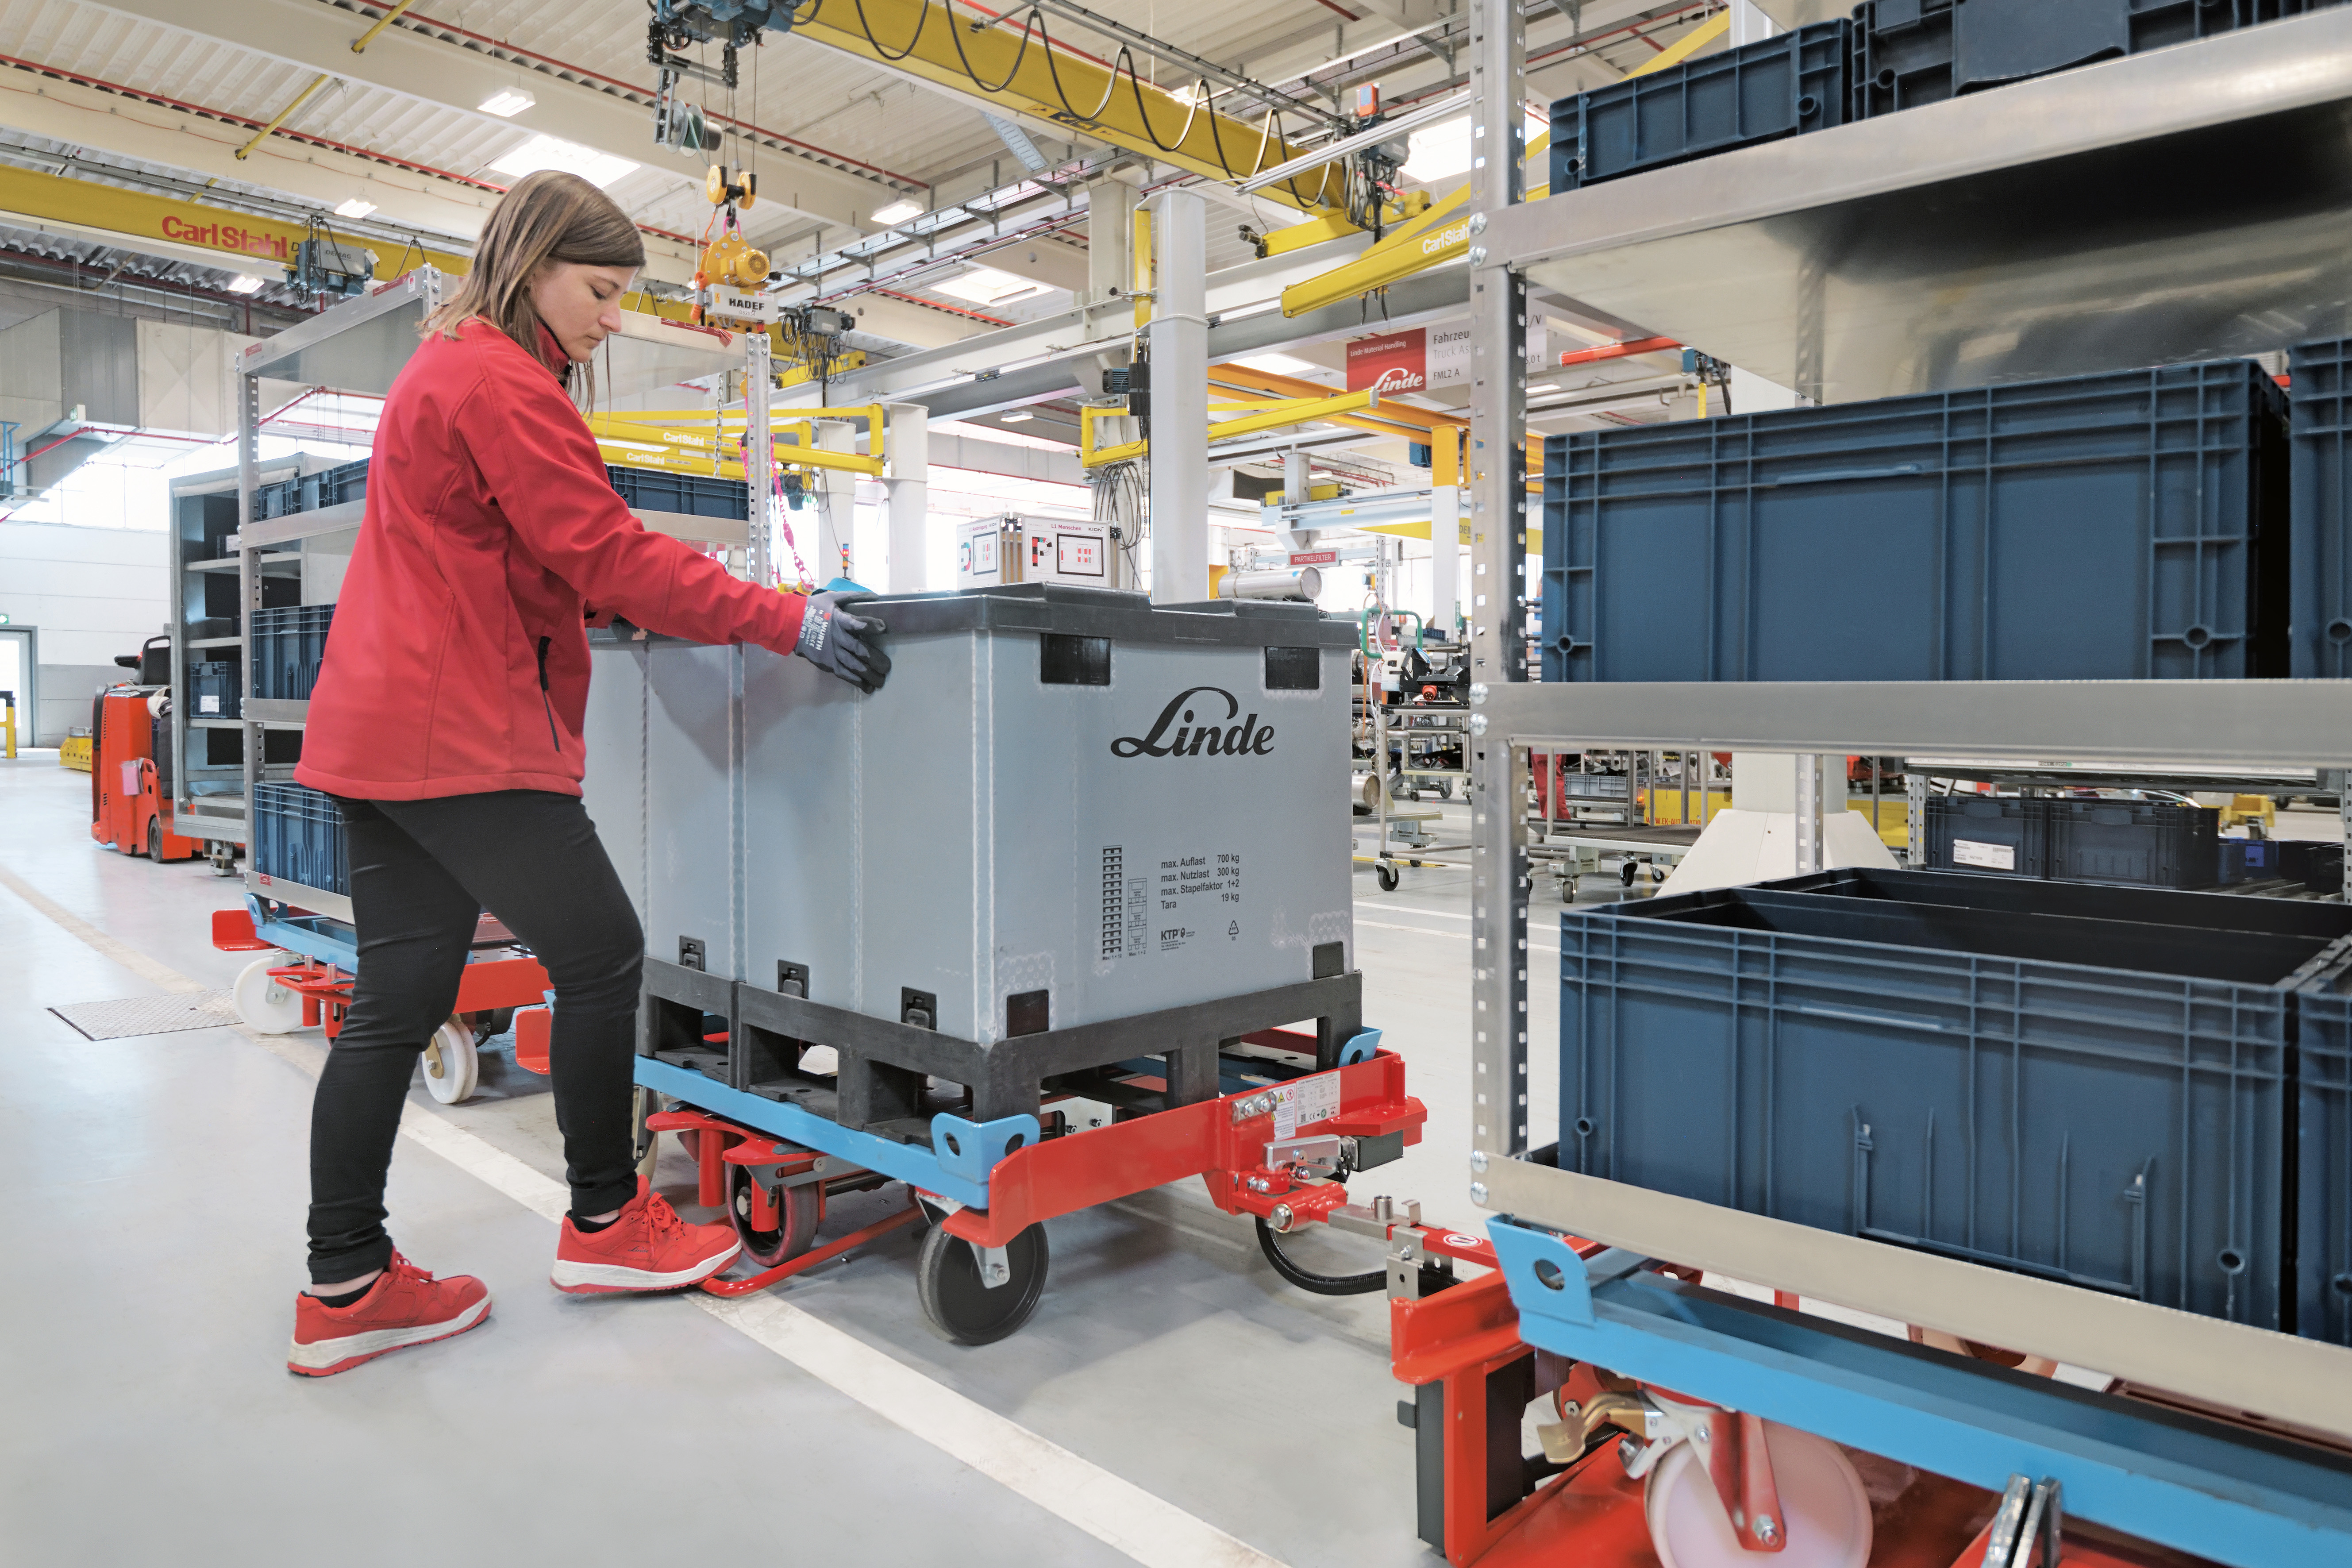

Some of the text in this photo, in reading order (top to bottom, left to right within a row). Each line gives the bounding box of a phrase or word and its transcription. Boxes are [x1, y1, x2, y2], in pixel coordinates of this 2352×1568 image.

[162, 216, 288, 258] Carl Stahl
[1423, 224, 1470, 254] Carl Stah
[729, 298, 765, 311] HADEF
[1364, 344, 1384, 354] Material
[1384, 340, 1406, 349] Handling
[1434, 347, 1456, 360] Truck
[1374, 368, 1424, 393] Linde
[1434, 370, 1452, 381] FML2
[663, 432, 682, 443] Carl
[682, 435, 704, 446] Stahl
[627, 453, 644, 462] Carl
[645, 455, 665, 465] Stahl
[1295, 554, 1332, 562] PARTIKELFILTER
[1111, 686, 1274, 757] Linde
[1161, 853, 1240, 869] max. Auflast 700 kg
[1161, 867, 1240, 882] max. Nutzlast 300 kg
[1161, 879, 1240, 896] max. Stapelfaktor 1+2
[1161, 893, 1240, 909] Tara 19 kg
[1161, 929, 1178, 941] KTP
